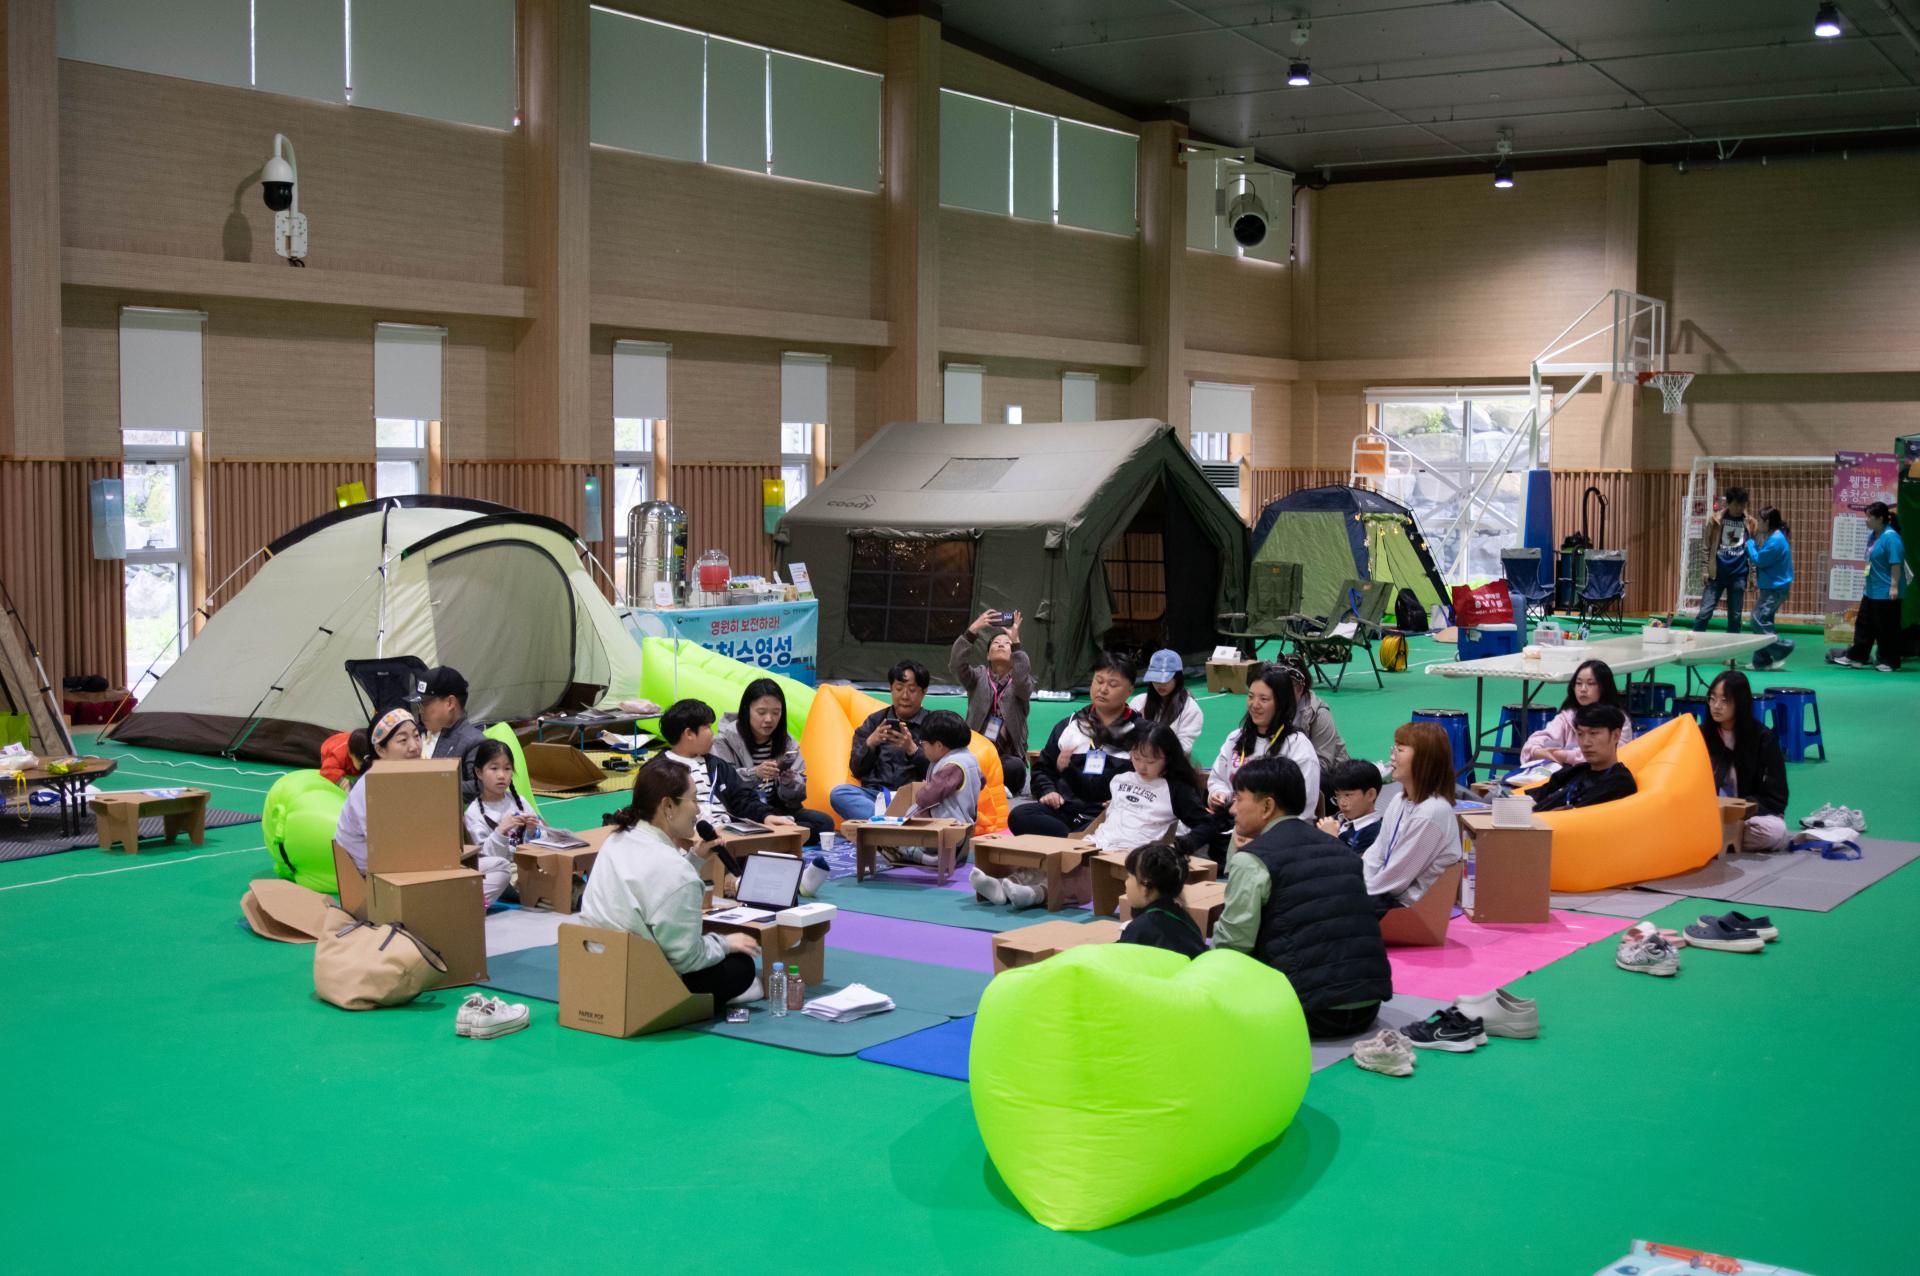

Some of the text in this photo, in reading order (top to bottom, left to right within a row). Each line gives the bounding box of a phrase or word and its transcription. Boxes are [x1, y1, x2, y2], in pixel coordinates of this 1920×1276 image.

[1873, 476, 1883, 489] 투
[827, 499, 874, 511] coody
[711, 620, 739, 636] 영원히
[741, 615, 780, 632] 보전하라!
[1118, 783, 1157, 802] NEW CLASIC
[578, 1009, 594, 1019] PAPER
